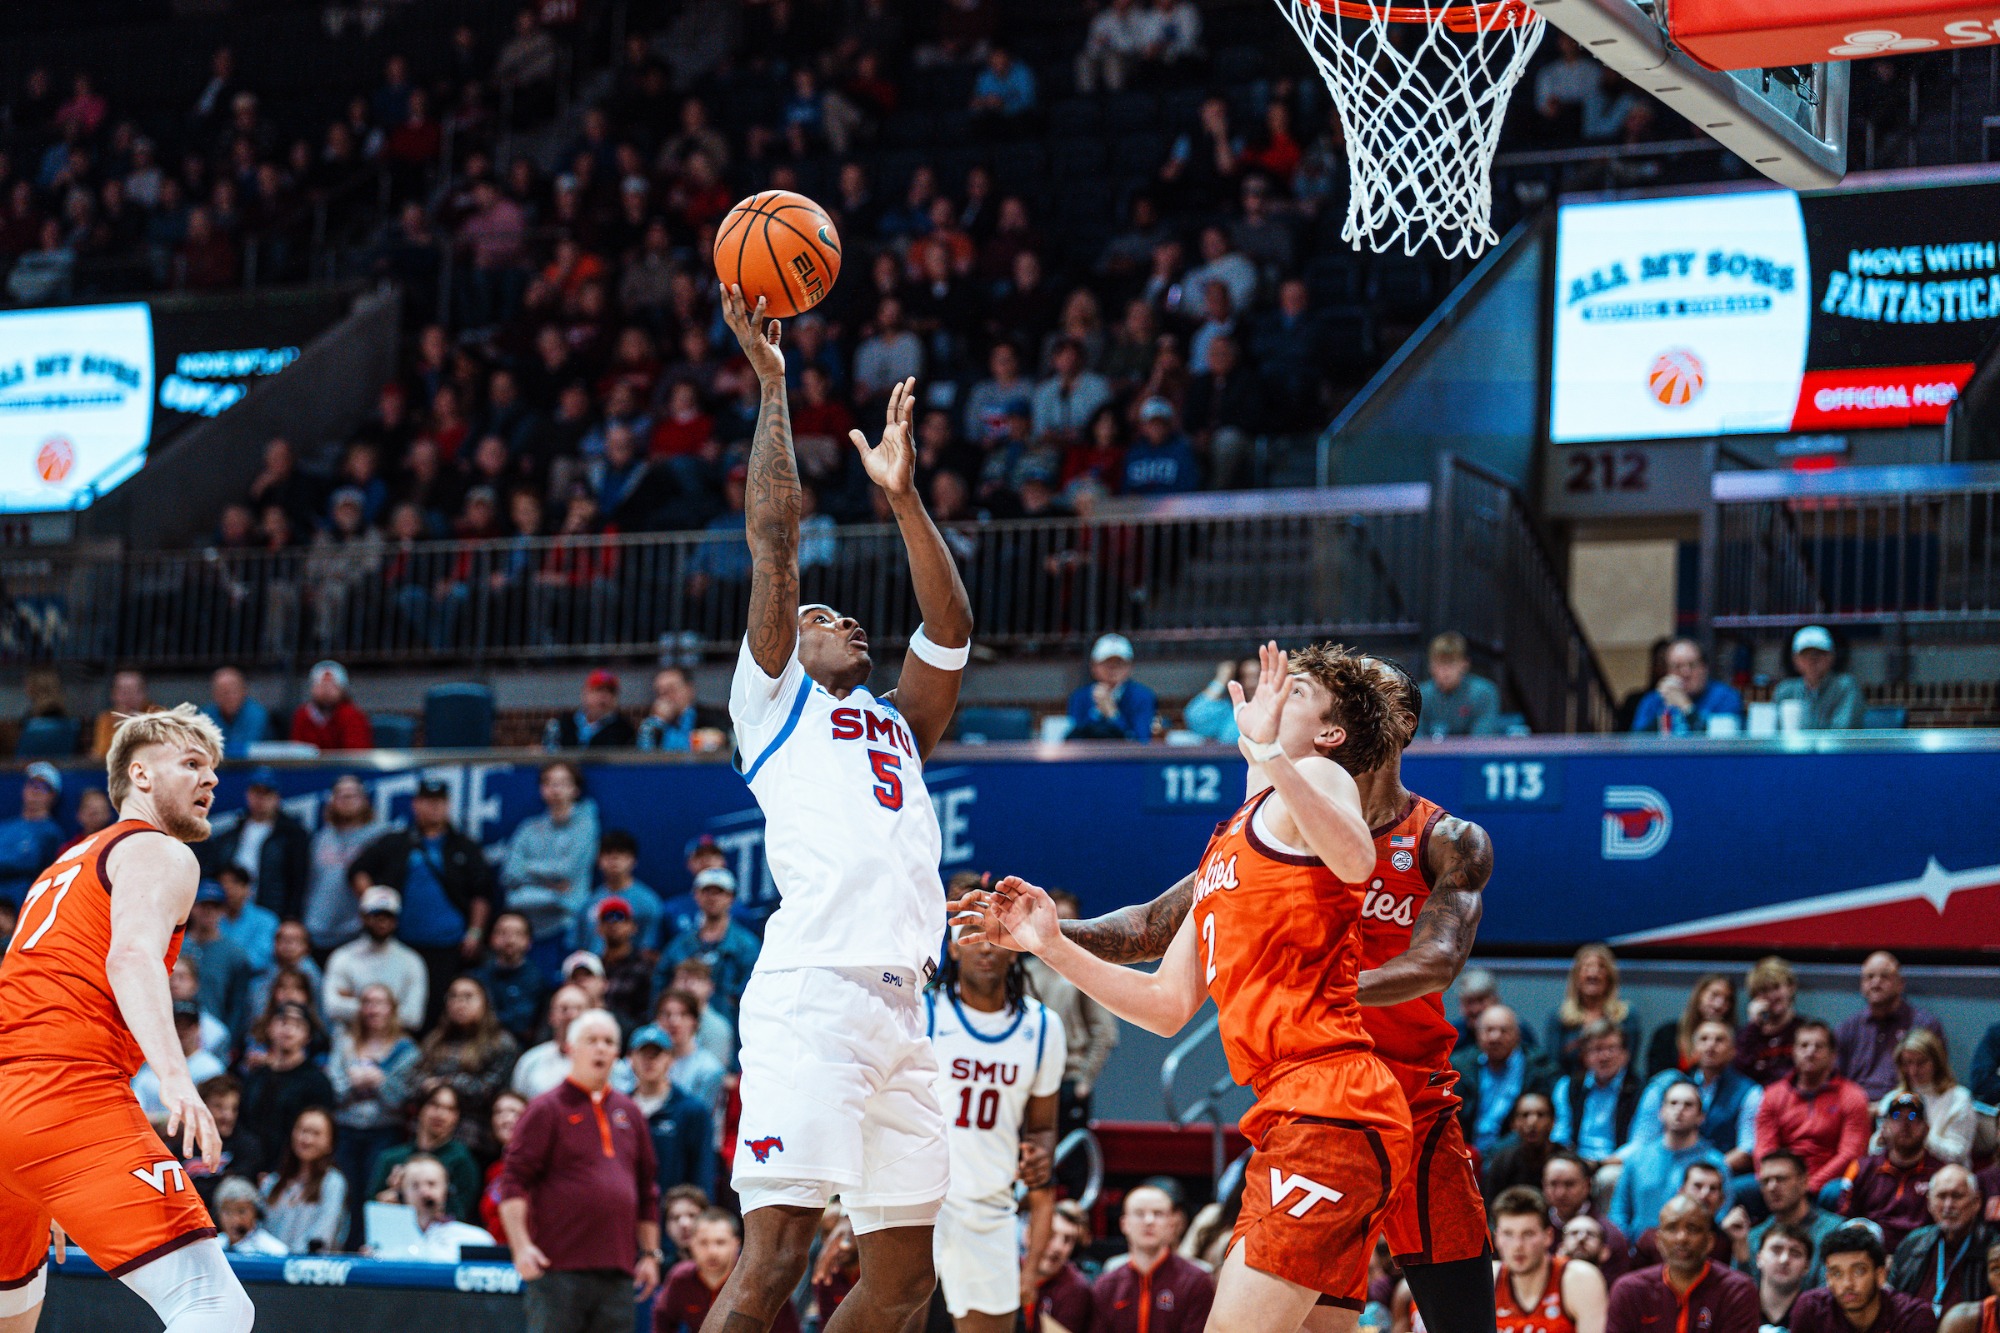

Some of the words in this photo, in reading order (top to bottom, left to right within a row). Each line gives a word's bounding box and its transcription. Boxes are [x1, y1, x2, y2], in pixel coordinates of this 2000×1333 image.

[792, 251, 825, 304] ELITE
[1567, 263, 1630, 304] ALL
[1640, 252, 1696, 281] MY
[1706, 250, 1795, 292] SONS
[1848, 245, 1923, 276] MOVE
[1924, 241, 1995, 272] WITH
[1814, 384, 1911, 411] OFFICIAL
[1565, 452, 1649, 492] 212
[830, 707, 913, 759] SMU
[867, 748, 904, 812] 5
[1162, 764, 1222, 803] 112
[1481, 762, 1545, 800] 113
[5, 861, 84, 953] 77
[1202, 910, 1218, 989] 2
[882, 971, 903, 988] SMU
[951, 1057, 1019, 1086] SMU
[954, 1085, 1001, 1130] 10
[128, 1159, 187, 1197] VT
[1268, 1165, 1347, 1220] VT
